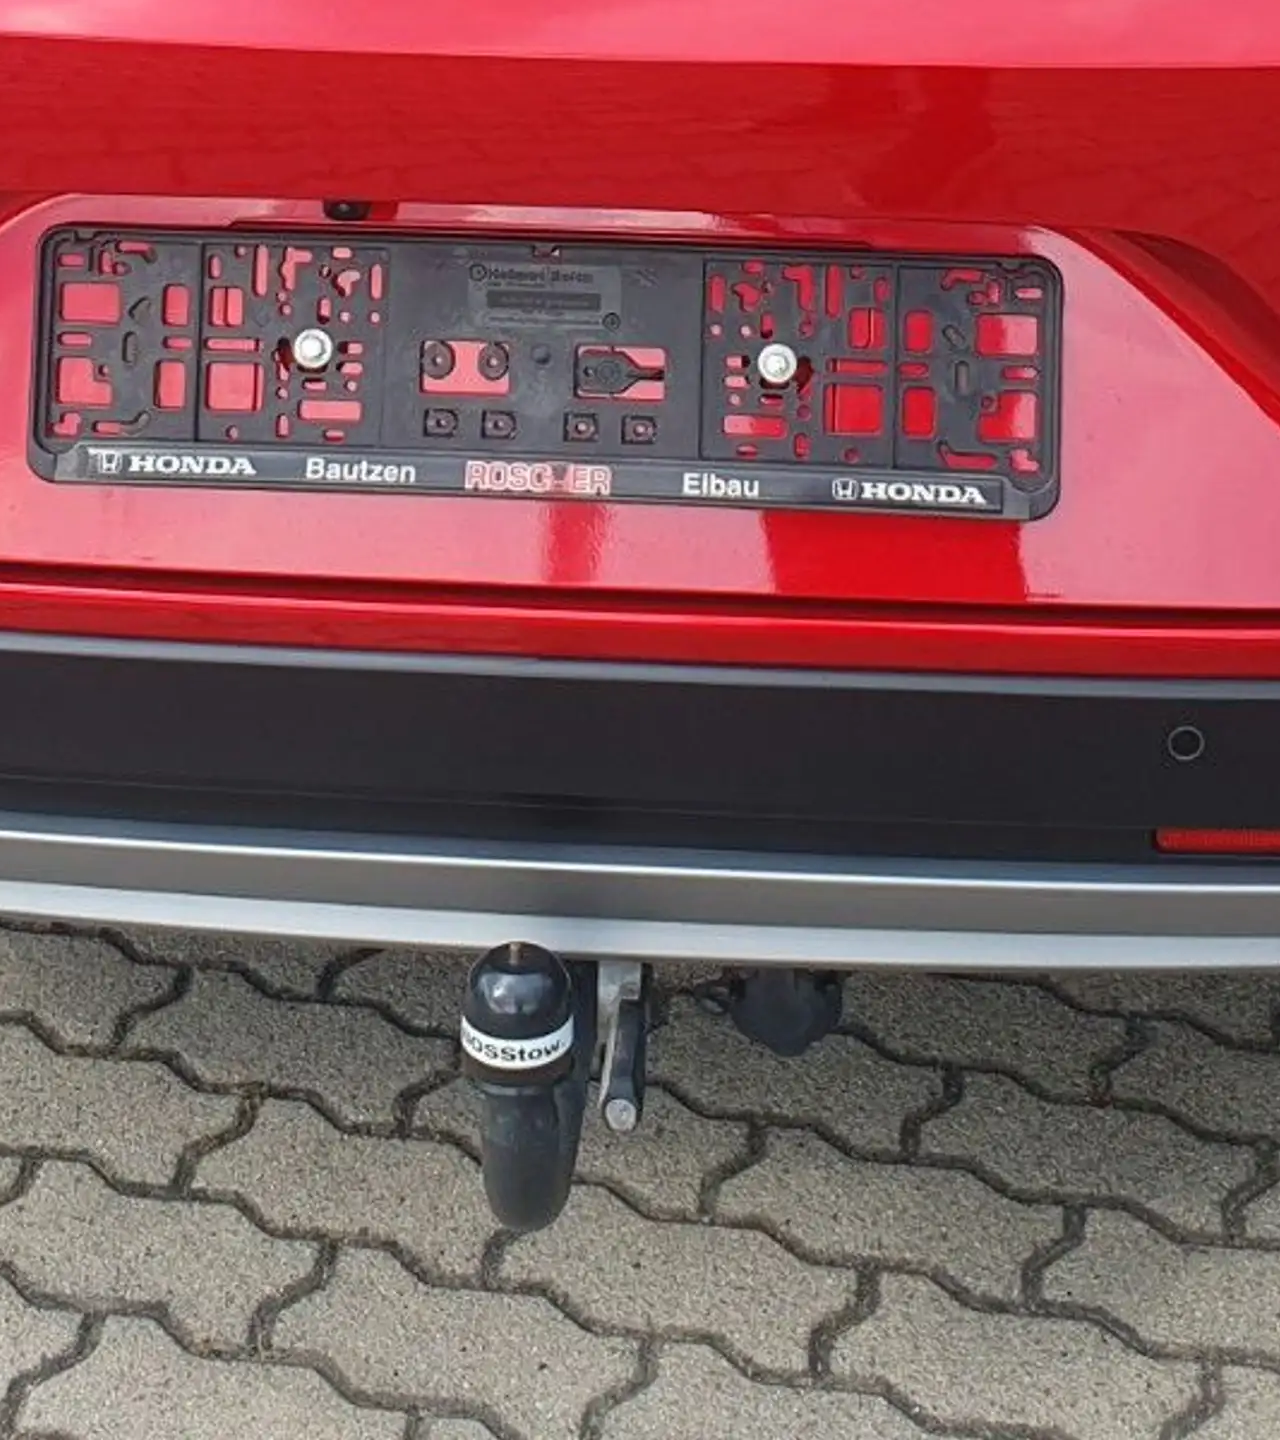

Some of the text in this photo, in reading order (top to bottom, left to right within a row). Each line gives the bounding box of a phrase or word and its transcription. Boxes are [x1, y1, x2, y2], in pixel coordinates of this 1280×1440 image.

[128, 454, 987, 504] HONDA Bautzen ROSCER Elbau HONDA
